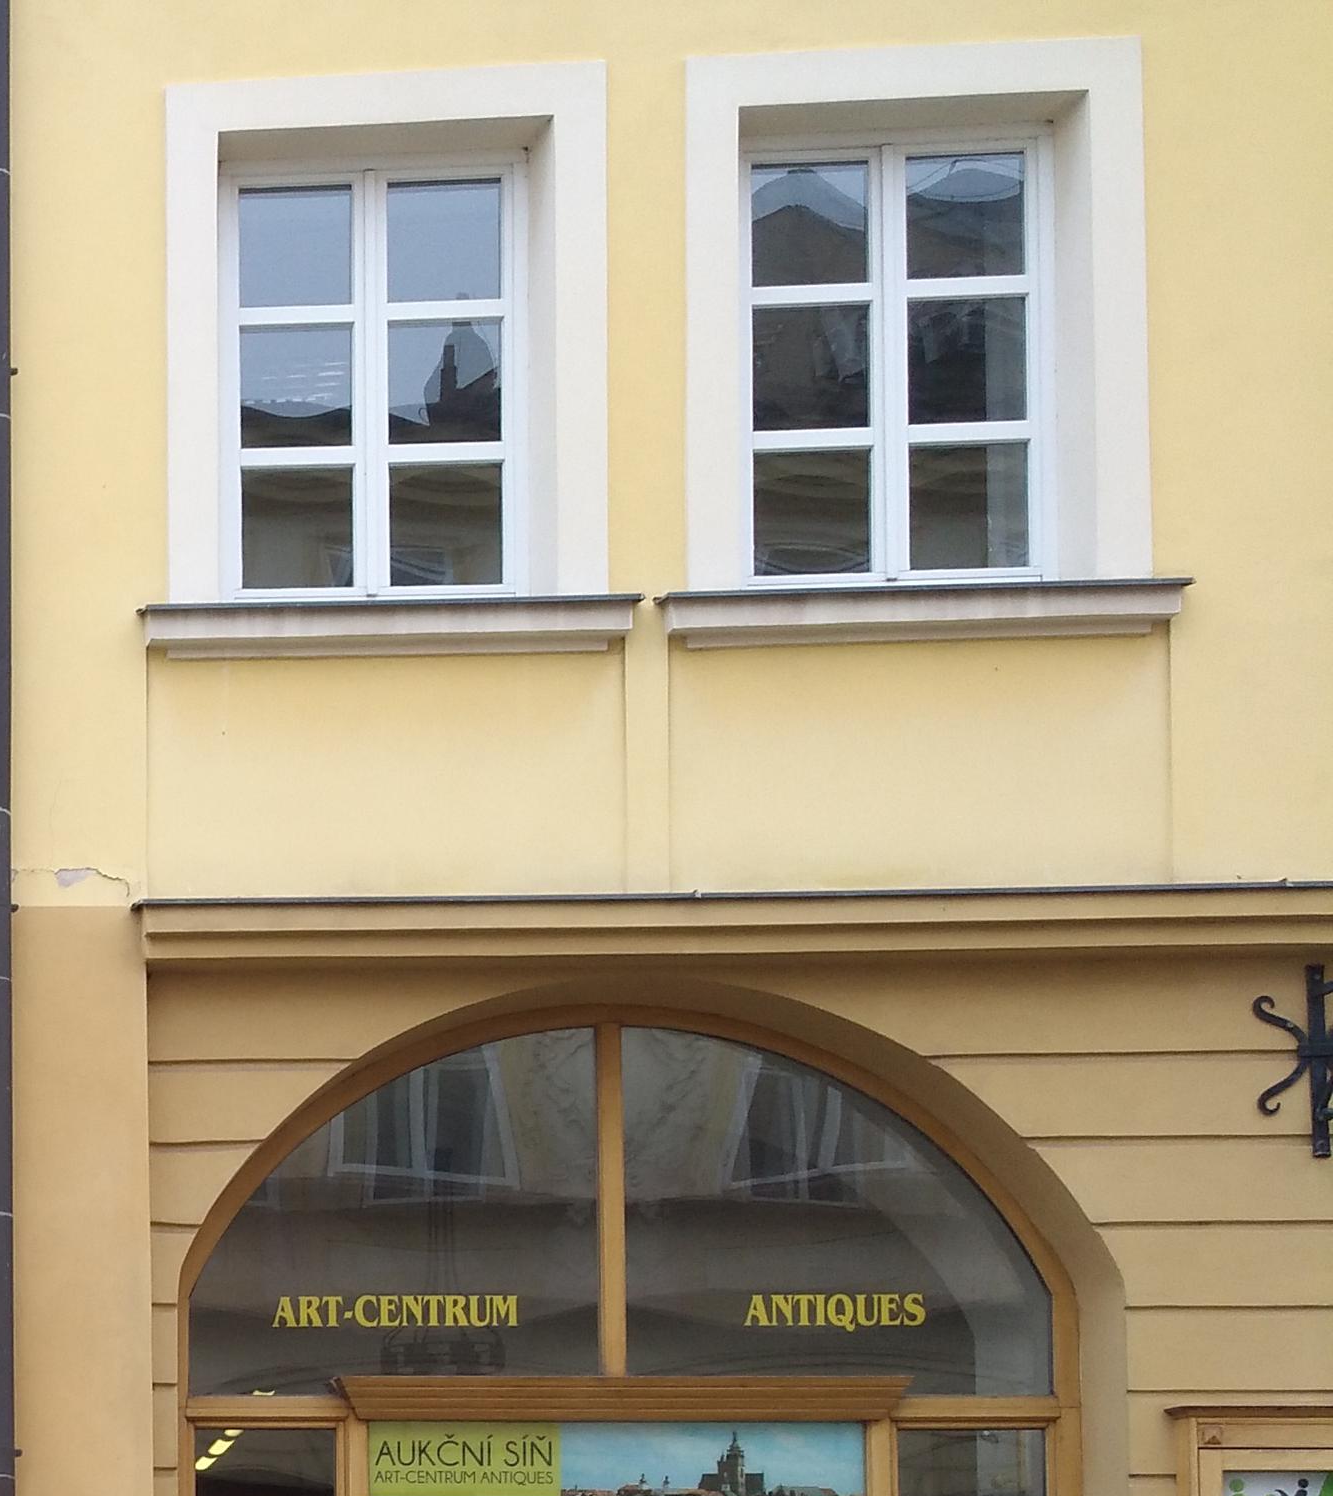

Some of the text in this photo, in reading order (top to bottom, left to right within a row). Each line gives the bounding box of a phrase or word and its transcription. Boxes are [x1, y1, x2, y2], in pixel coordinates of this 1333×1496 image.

[272, 1294, 519, 1329] ART-CENTRUM
[743, 1292, 927, 1333] ANTIQUES
[374, 1433, 553, 1467] AUKČNÍ SÍŇ
[374, 1470, 554, 1486] ART-CENTRUM ANTIQUES
